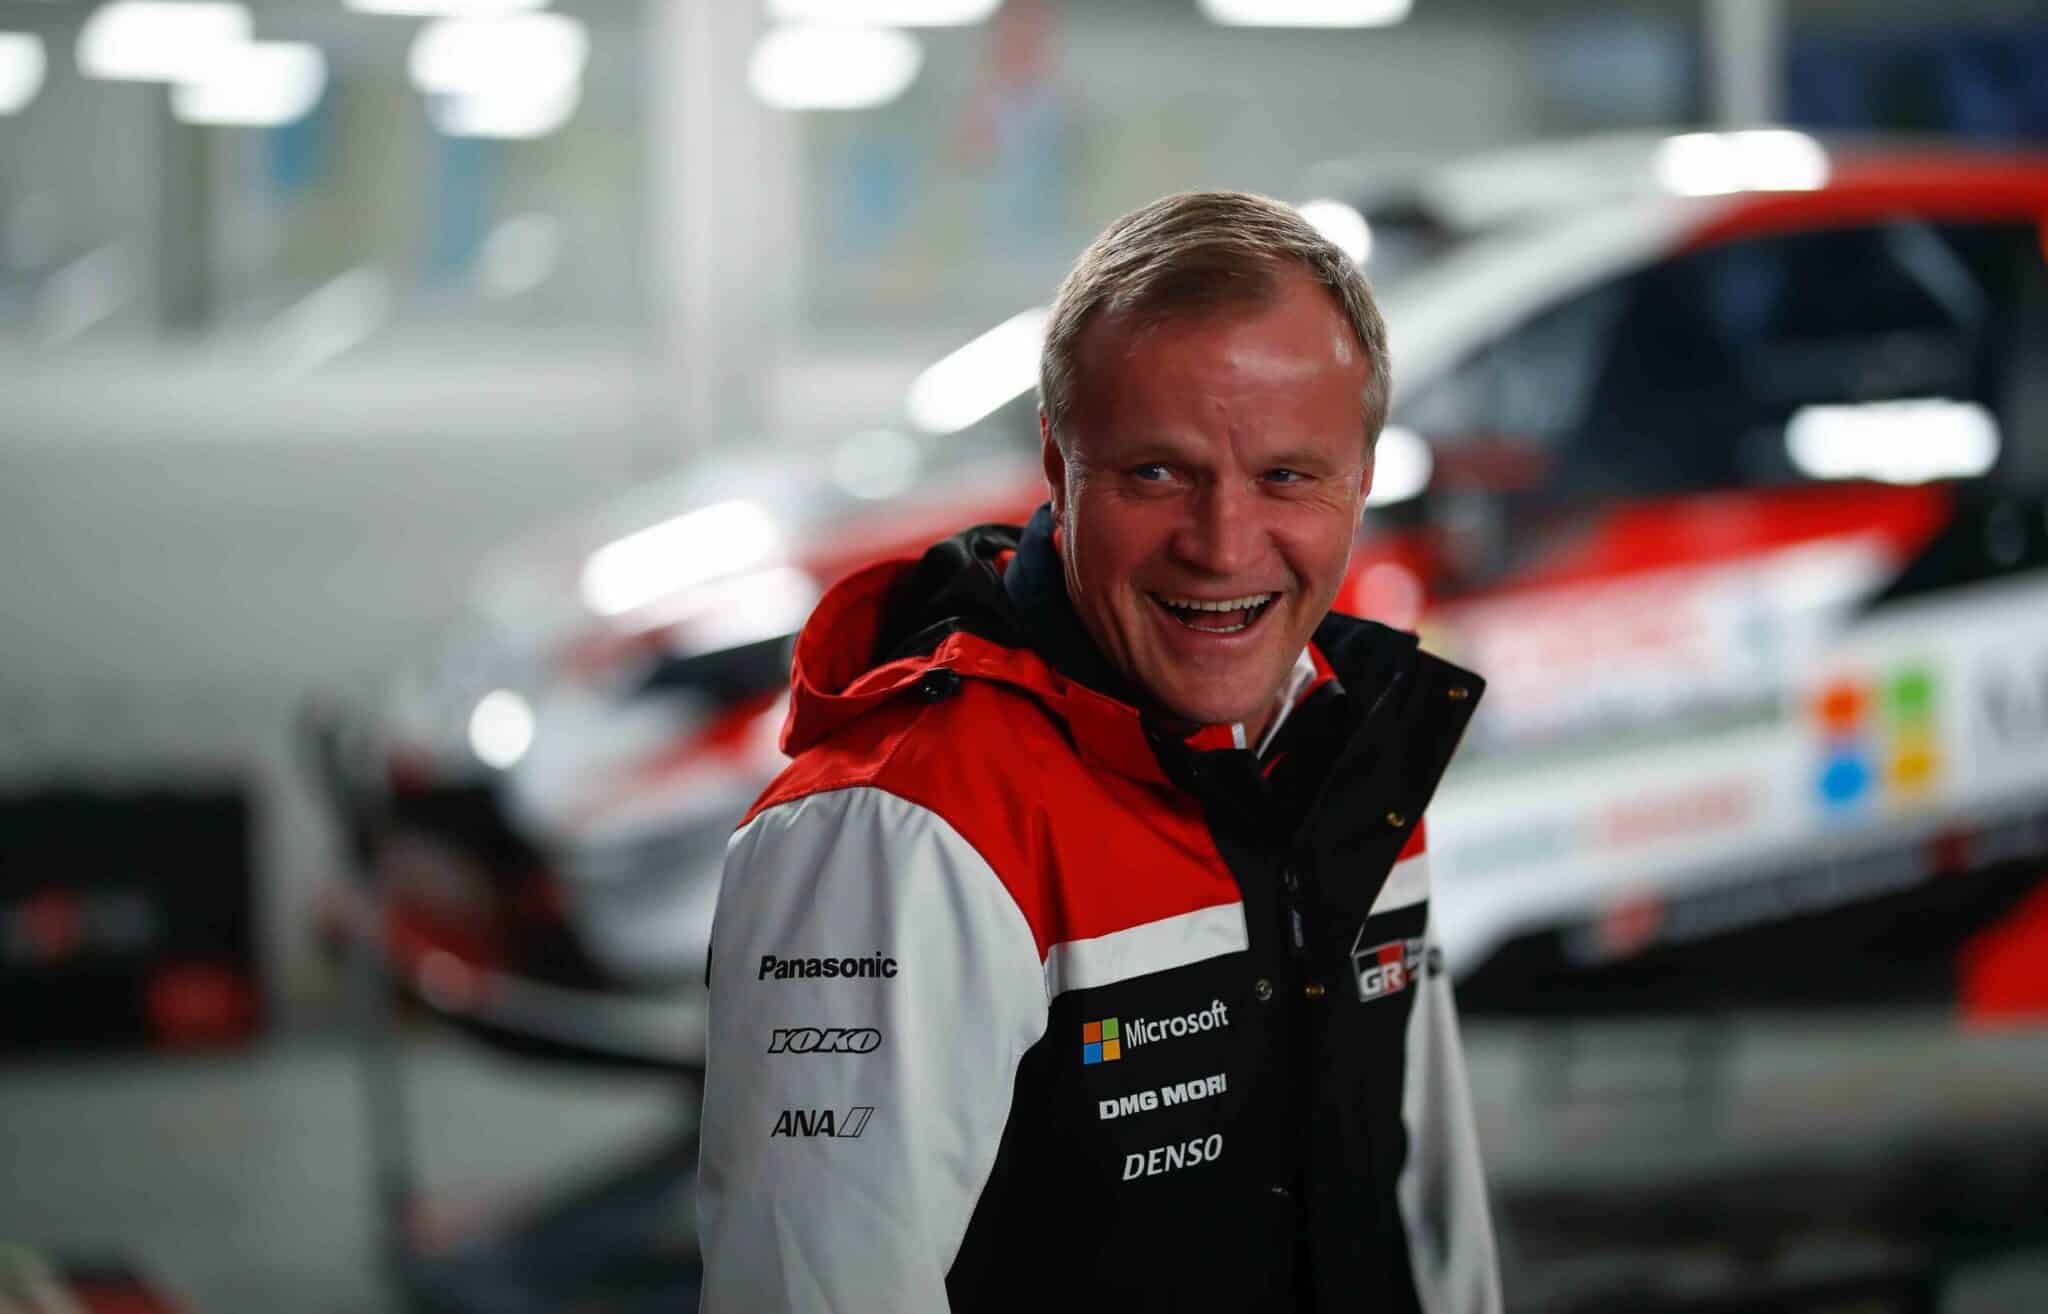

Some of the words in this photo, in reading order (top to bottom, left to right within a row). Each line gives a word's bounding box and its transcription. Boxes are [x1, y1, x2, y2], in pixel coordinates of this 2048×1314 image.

[758, 951, 898, 980] Panasonic
[1360, 961, 1406, 996] GR
[767, 1028, 882, 1054] YOKO
[1125, 999, 1229, 1049] Microsoft
[1099, 1090, 1159, 1120] DMG
[1161, 1072, 1228, 1107] MORI
[770, 1109, 836, 1138] ANA
[1122, 1133, 1223, 1181] DENSO
